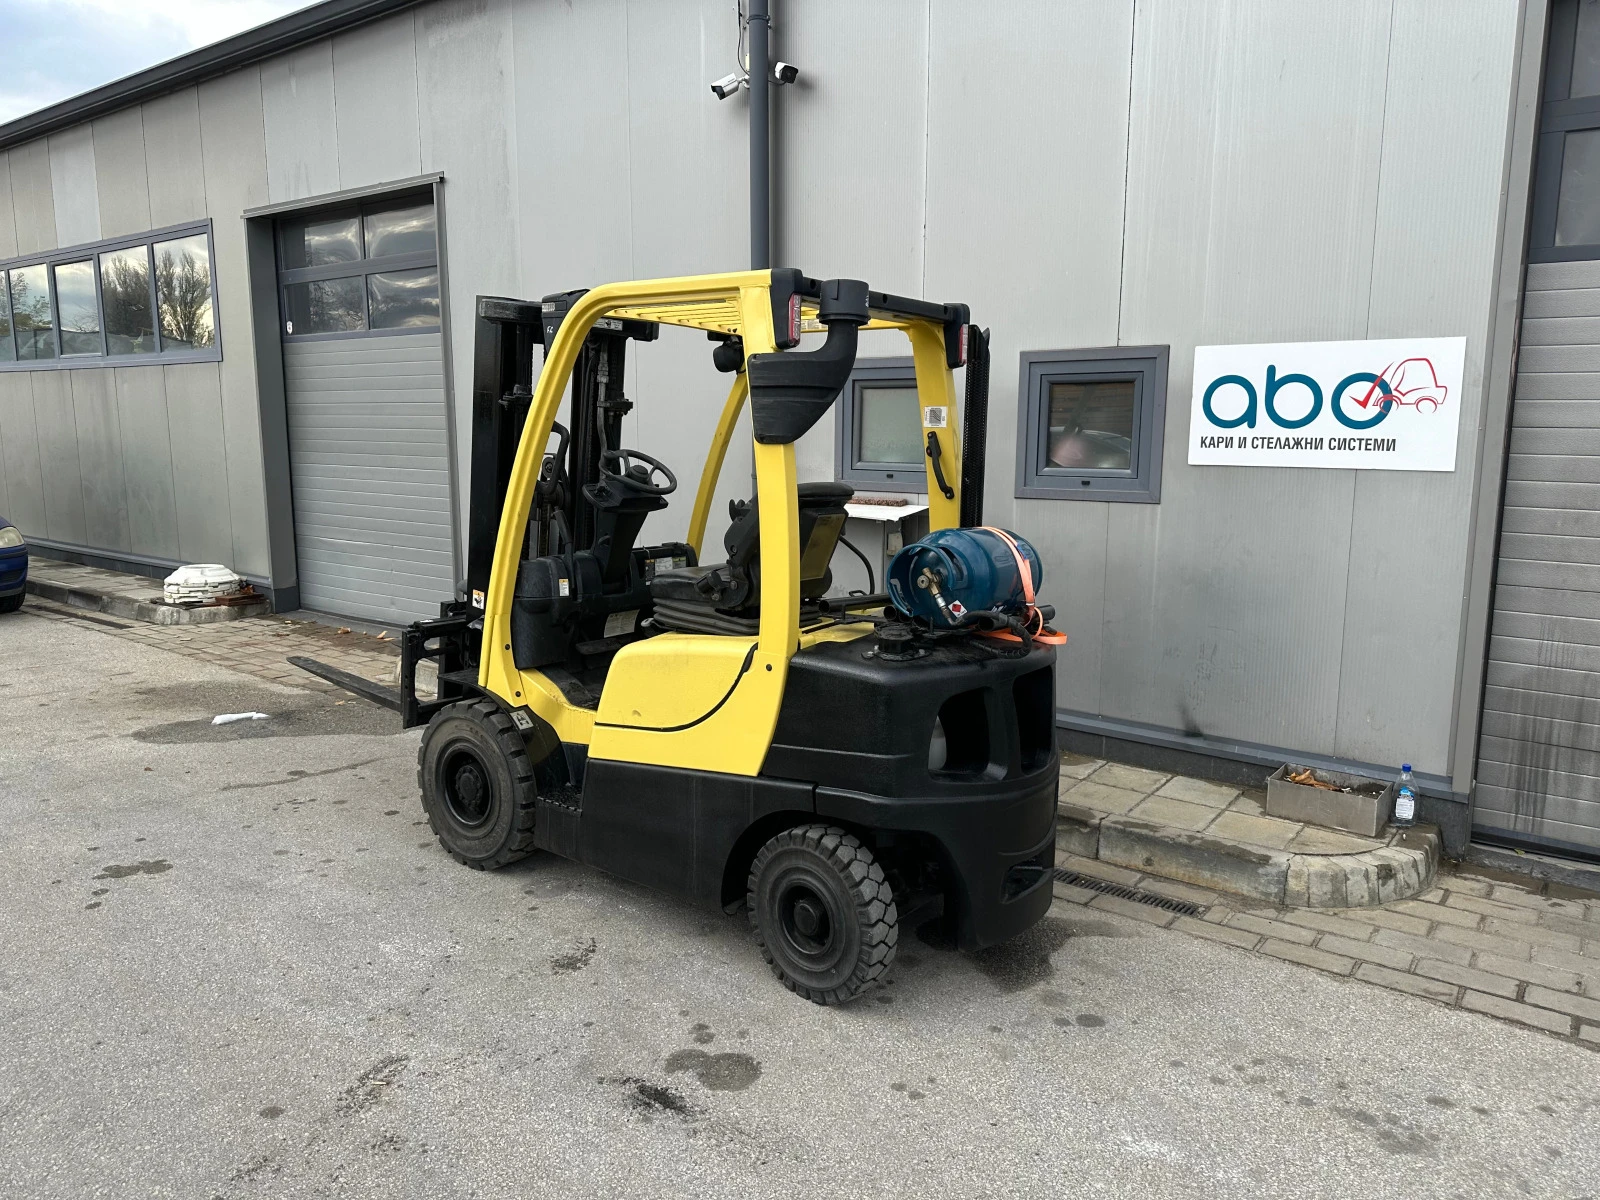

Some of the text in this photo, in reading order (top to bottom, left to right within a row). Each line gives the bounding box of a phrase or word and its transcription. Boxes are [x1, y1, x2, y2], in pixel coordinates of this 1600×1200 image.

[1202, 364, 1393, 430] abo
[1200, 436, 1397, 452] КАРИ И СТЕЛАЖНИ СИСТЕМИ
